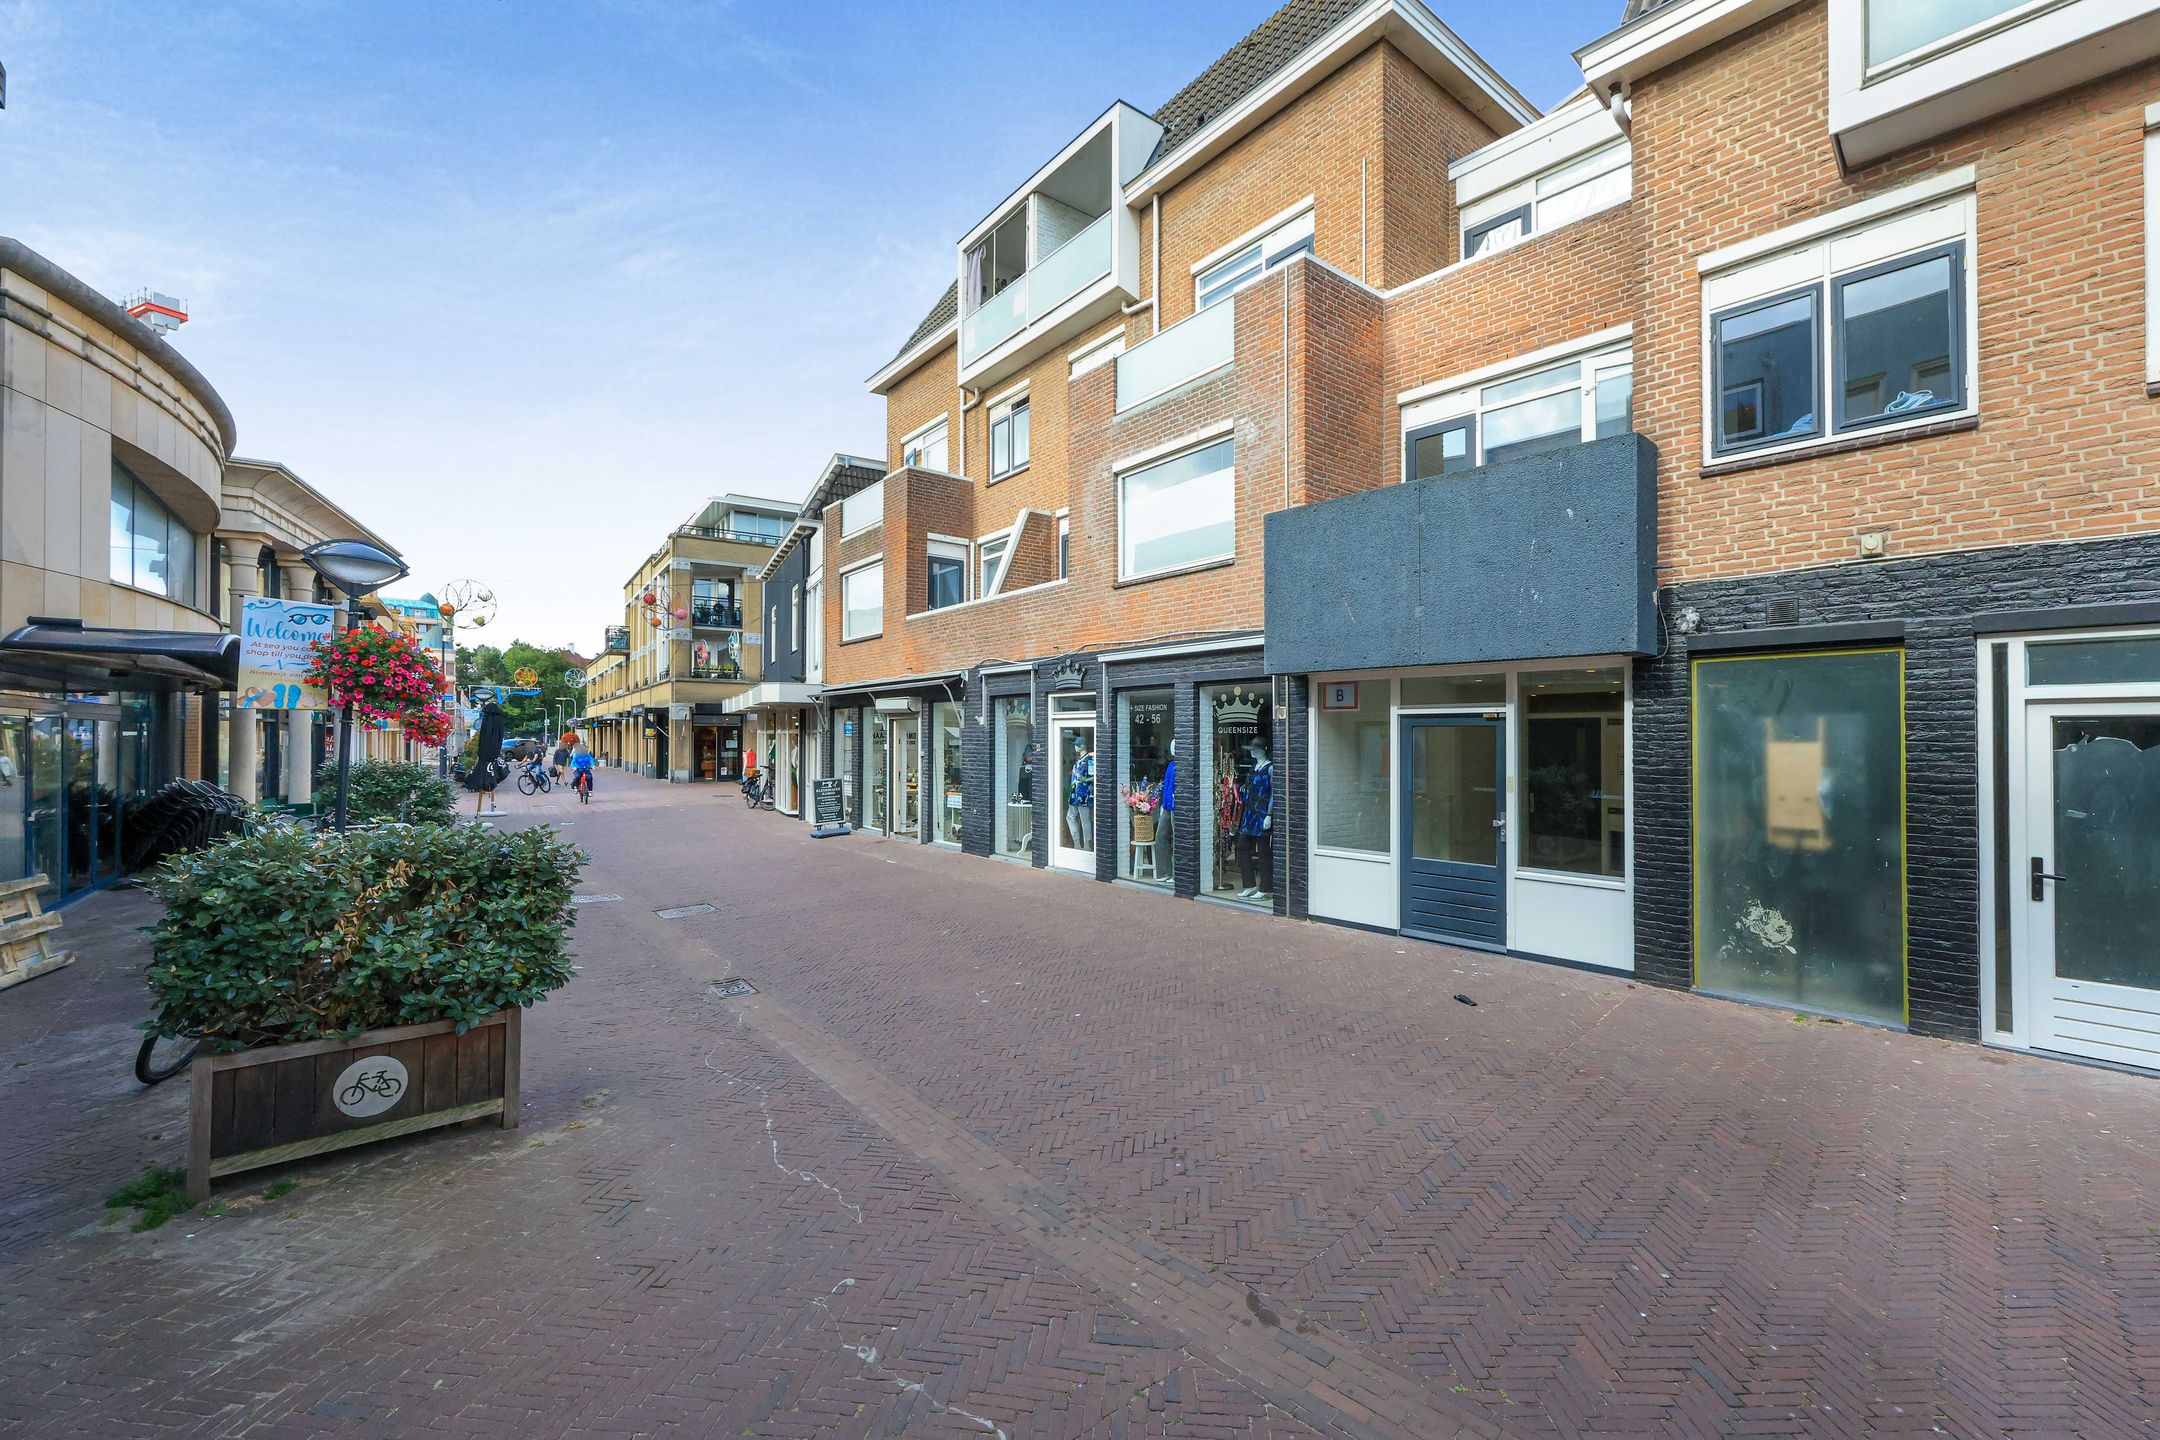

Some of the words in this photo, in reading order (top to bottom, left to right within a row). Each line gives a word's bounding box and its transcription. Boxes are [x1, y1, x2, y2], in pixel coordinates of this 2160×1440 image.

[246, 649, 269, 657] shop
[271, 650, 283, 658] till
[303, 653, 319, 661] dro
[1145, 703, 1168, 711] FASHION
[1135, 713, 1145, 724] 42
[1151, 713, 1161, 724] 56
[1217, 726, 1258, 734] QUEENSIZE
